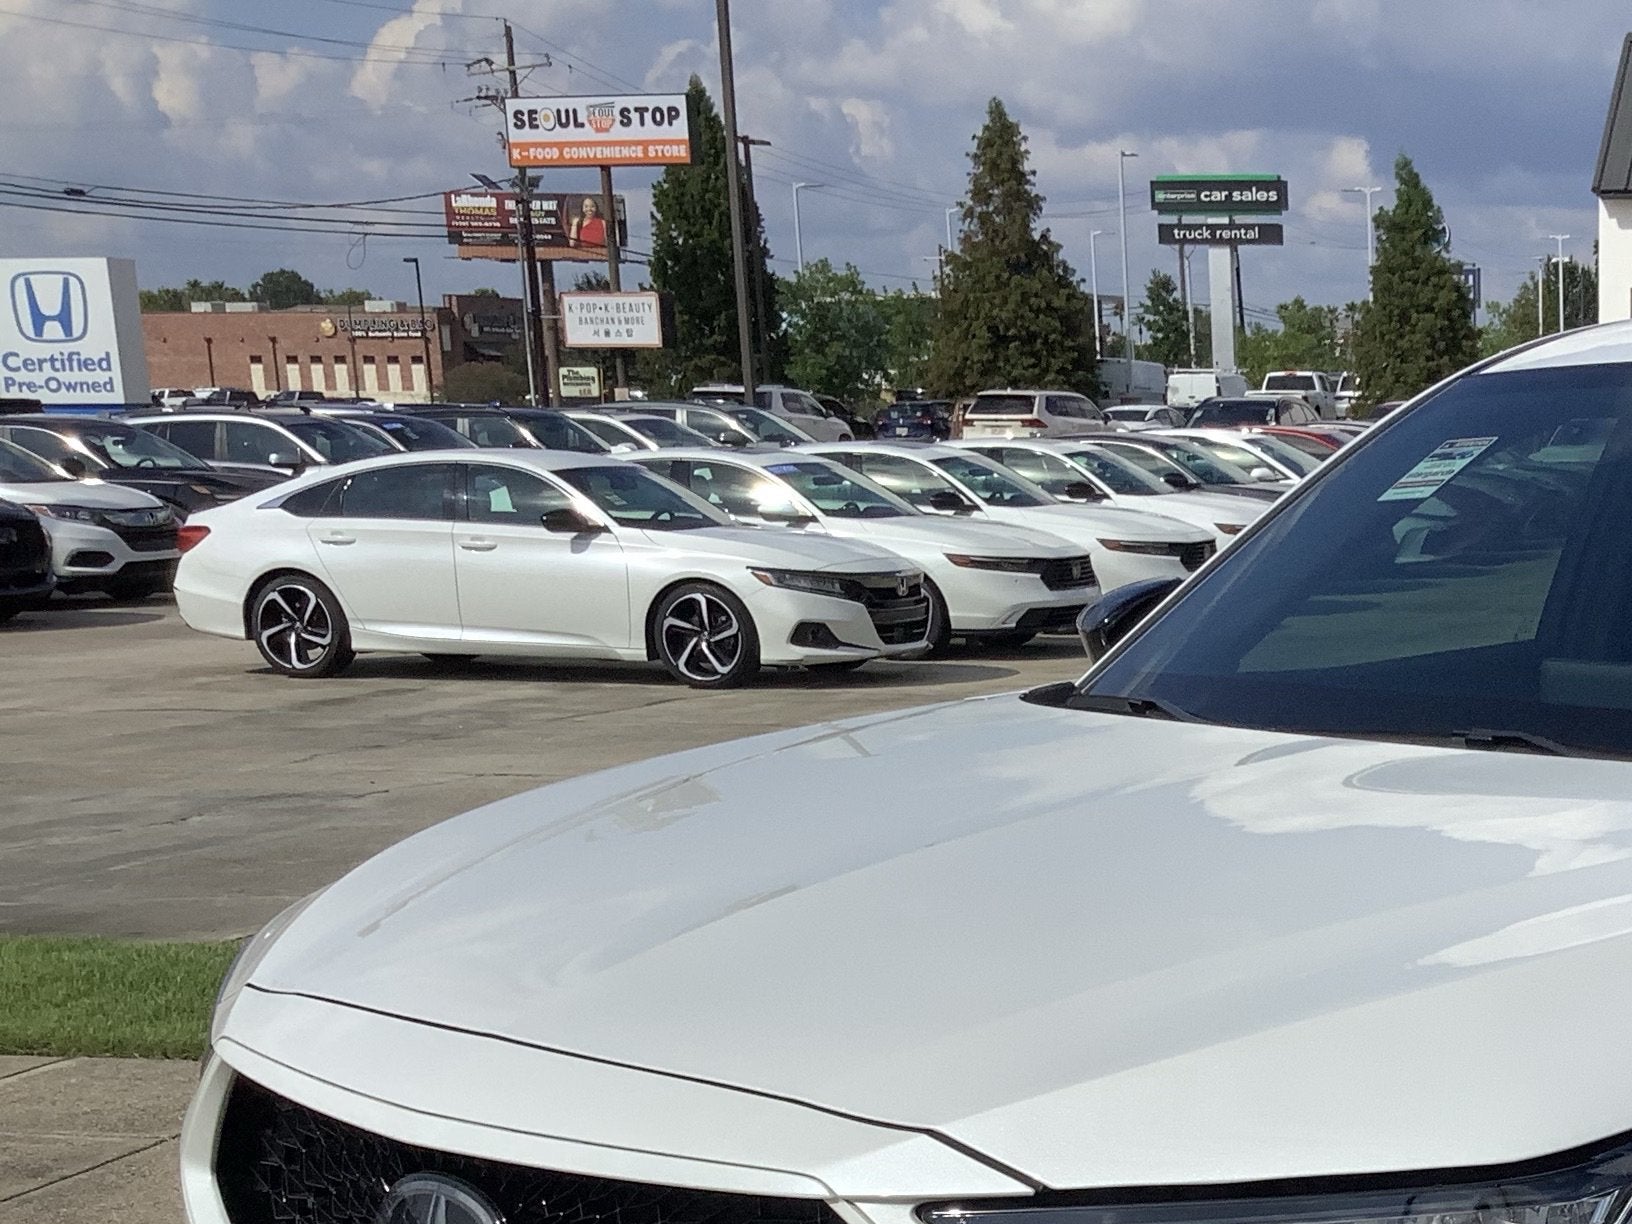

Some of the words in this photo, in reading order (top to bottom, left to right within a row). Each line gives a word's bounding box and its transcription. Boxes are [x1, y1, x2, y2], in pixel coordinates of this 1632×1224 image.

[513, 106, 585, 131] SEOUL
[619, 106, 680, 127] STOP
[512, 147, 559, 160] K-FOOD
[563, 145, 644, 159] CONVENIENCE
[647, 144, 686, 158] STORE
[1200, 190, 1228, 201] car
[1232, 186, 1278, 201] sales
[454, 207, 497, 216] THOMAS
[1173, 226, 1212, 239] truck
[1215, 226, 1259, 240] rental
[339, 319, 396, 330] DUMPLING
[399, 319, 409, 330] &
[579, 316, 616, 326] BANCHAN
[624, 316, 645, 326] MORE
[2, 351, 112, 372] Certified
[4, 376, 115, 394] Pre-Owned
